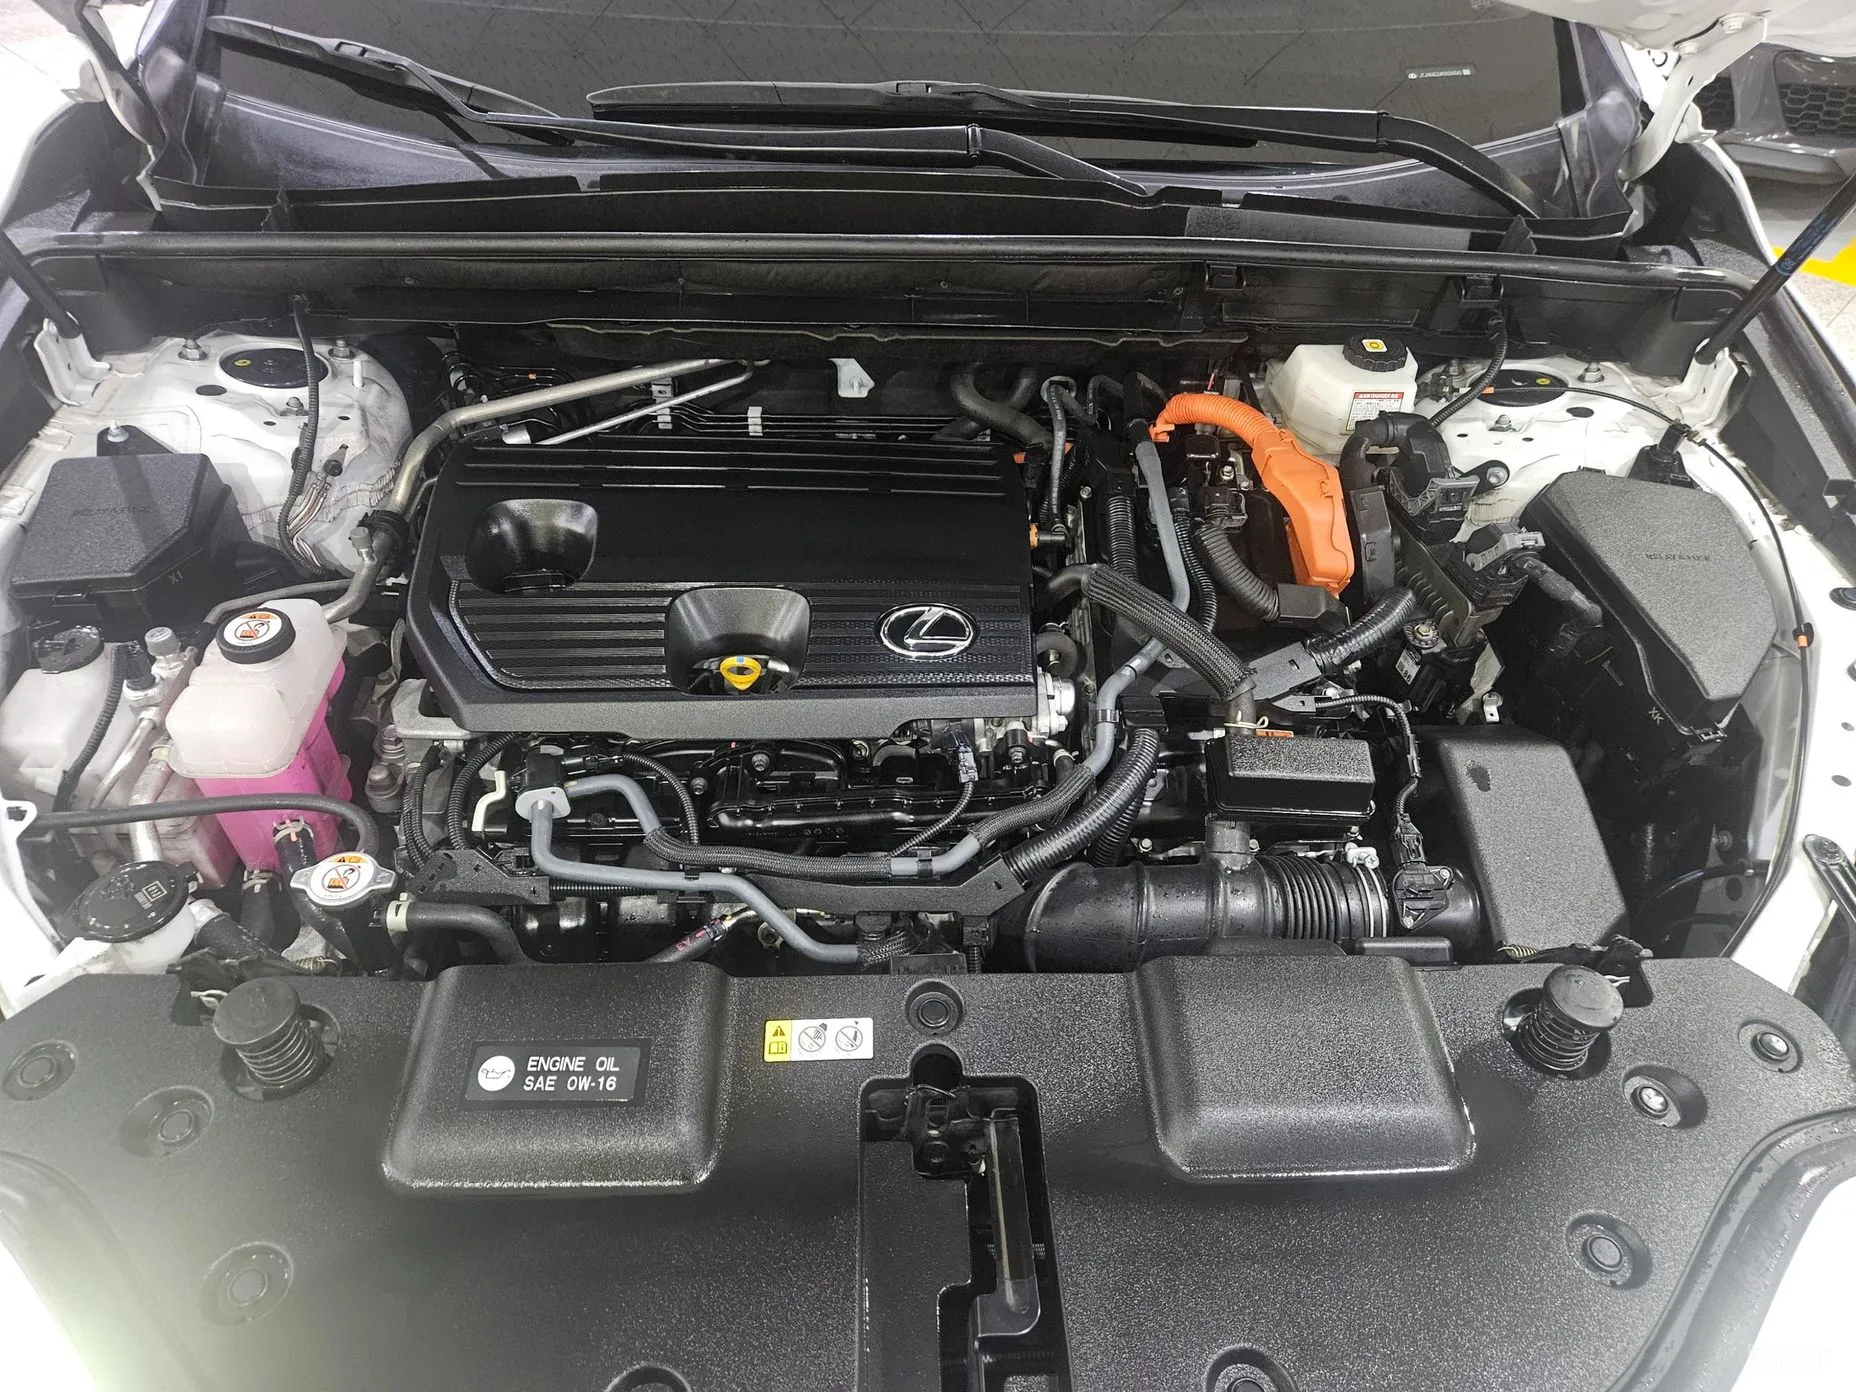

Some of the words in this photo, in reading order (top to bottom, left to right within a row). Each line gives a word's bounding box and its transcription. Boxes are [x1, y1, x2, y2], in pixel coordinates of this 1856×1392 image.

[526, 1056, 586, 1072] ENGINE
[595, 1056, 620, 1072] OIL
[523, 1076, 557, 1091] SAE
[567, 1076, 617, 1091] 0W-16
